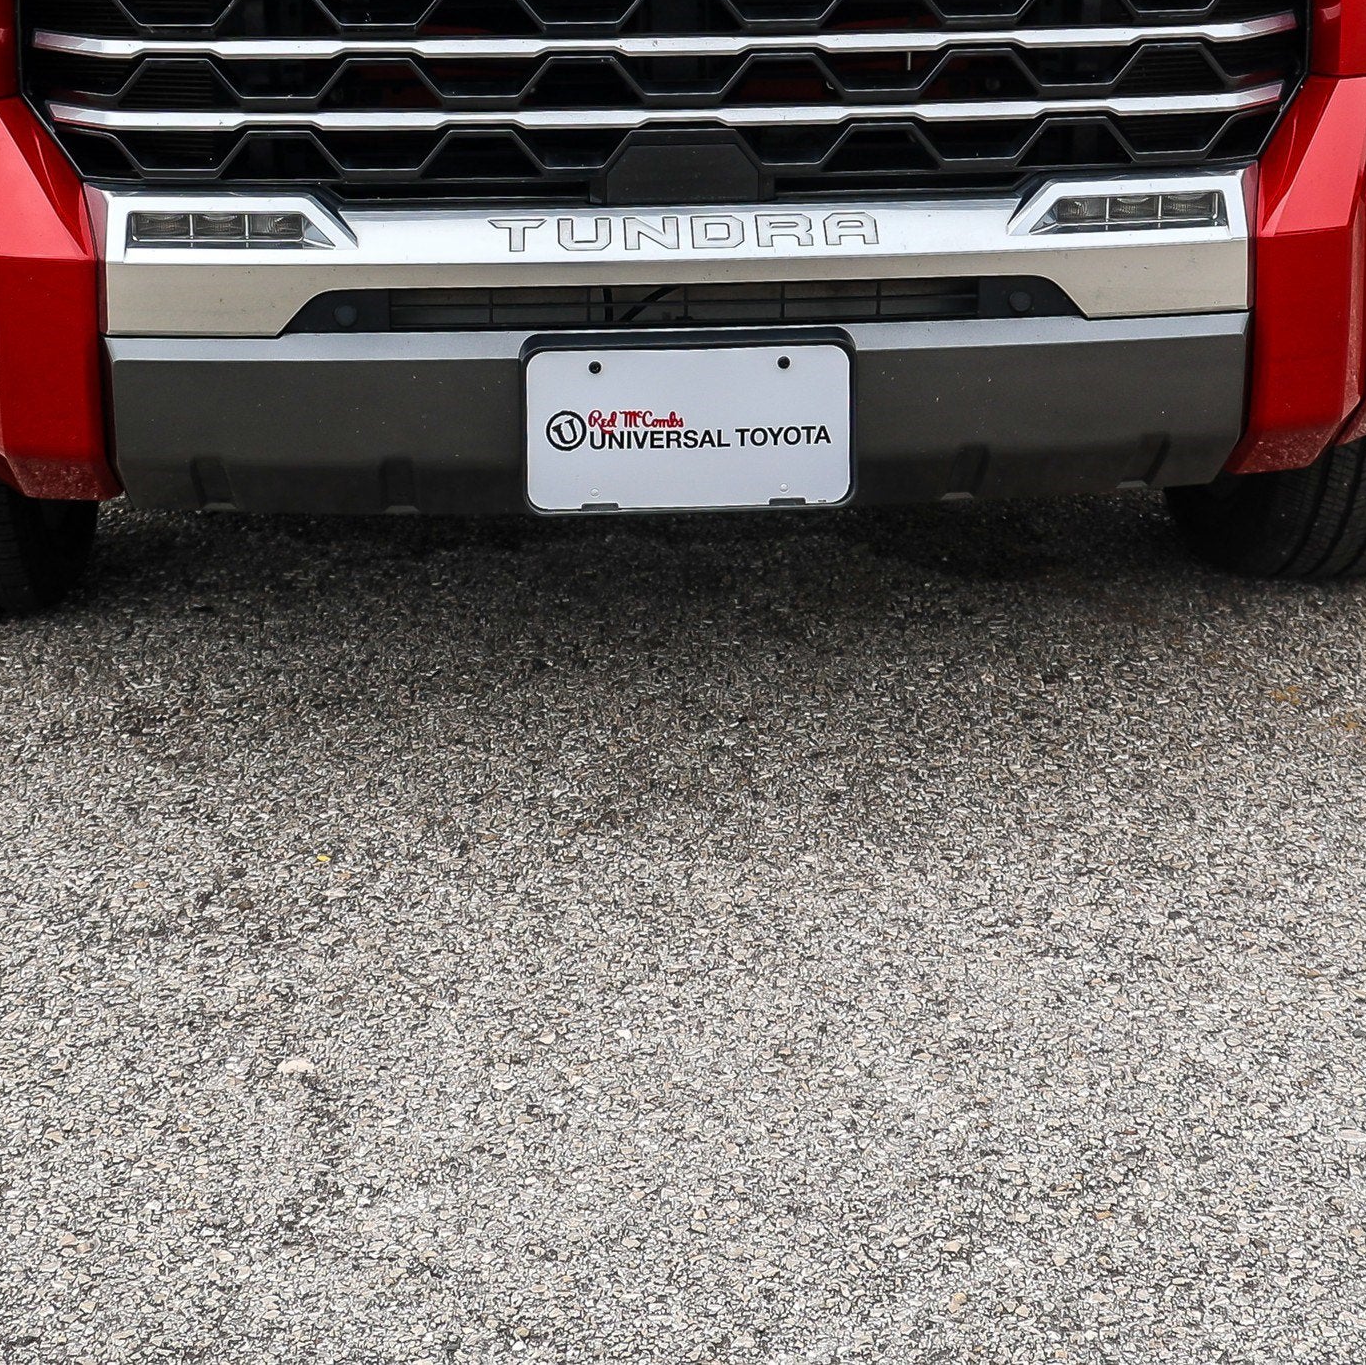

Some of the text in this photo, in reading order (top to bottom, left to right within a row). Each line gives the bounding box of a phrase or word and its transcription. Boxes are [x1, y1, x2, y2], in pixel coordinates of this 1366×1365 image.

[488, 212, 879, 252] TUNDRA
[588, 410, 684, 434] Red McCombs
[589, 425, 832, 450] UNIVERSAL TOYOTA
